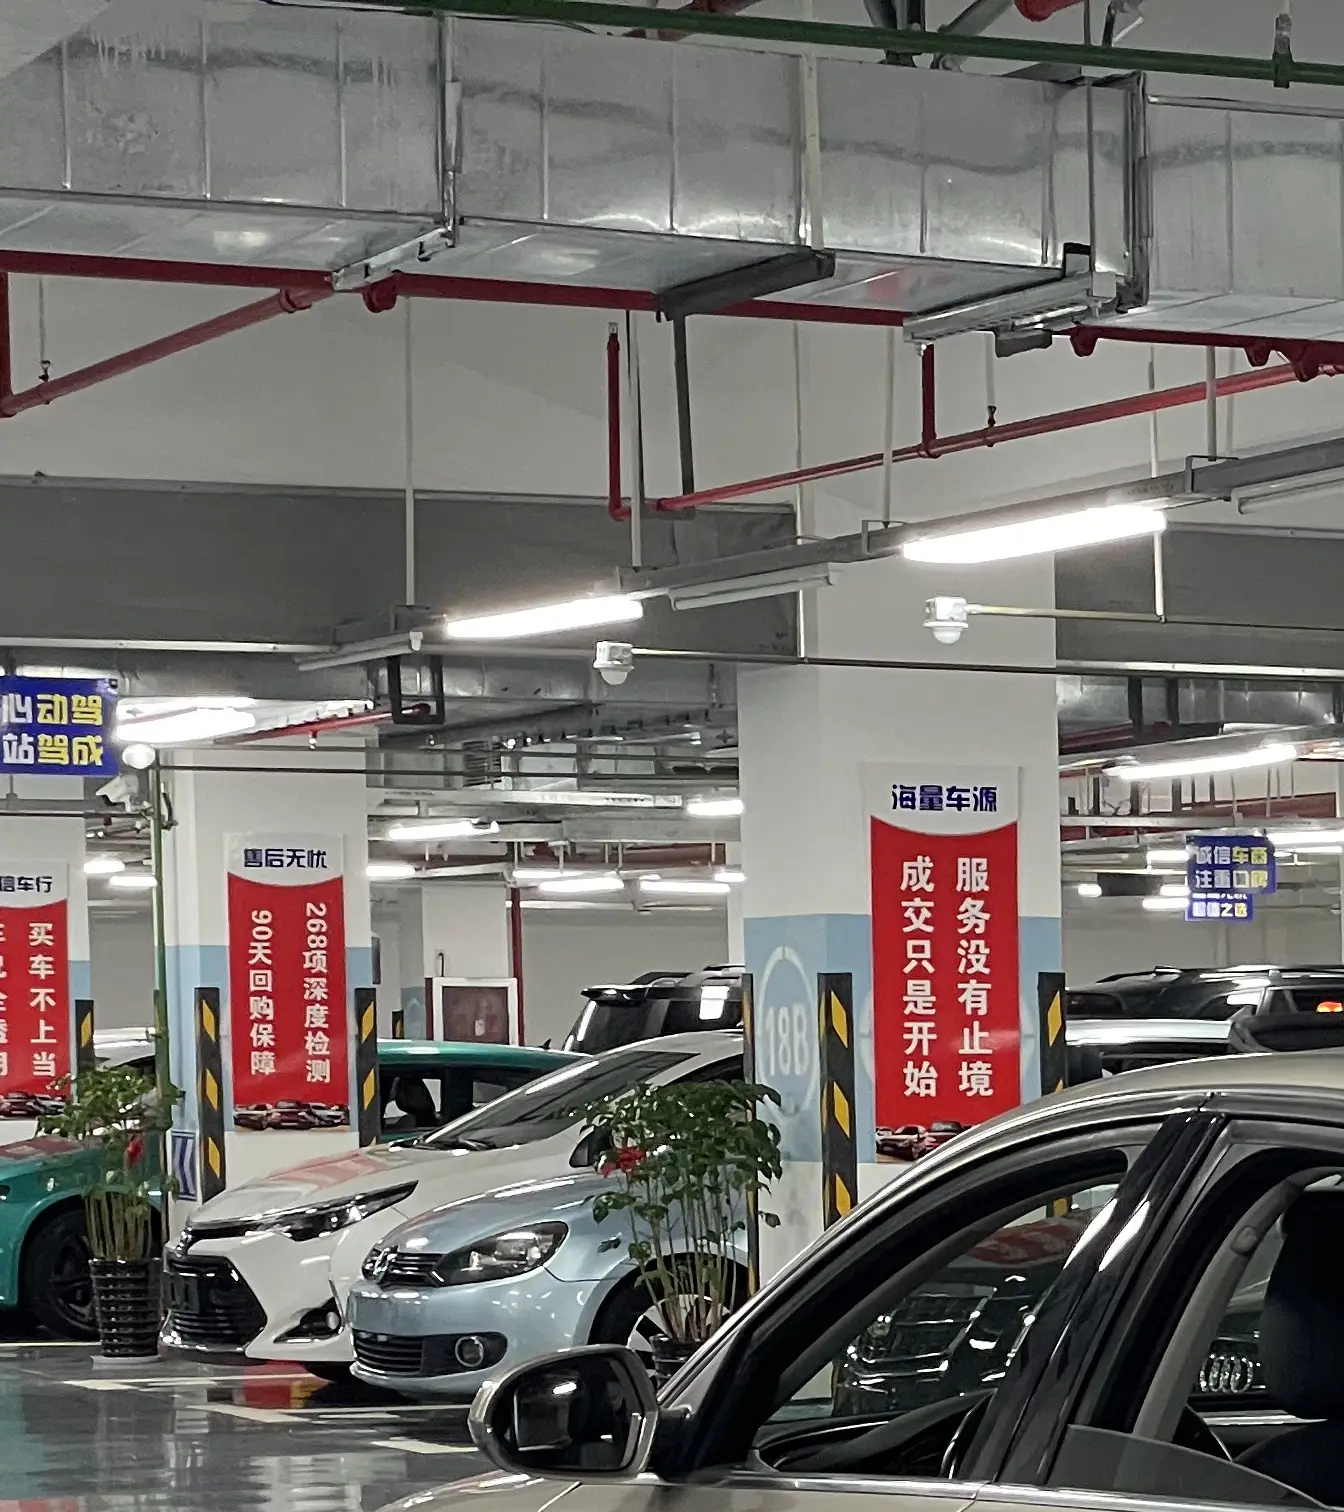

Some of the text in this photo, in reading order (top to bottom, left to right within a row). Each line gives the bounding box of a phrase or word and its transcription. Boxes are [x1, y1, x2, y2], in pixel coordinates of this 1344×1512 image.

[243, 848, 328, 869] 售后无忧
[891, 784, 998, 812] 海量车源
[28, 922, 58, 1078] 买车不上当
[248, 909, 277, 1077] 90天回购保障
[302, 902, 331, 1084] 268项深度检测
[899, 854, 938, 1098] 成交只是开始
[955, 857, 994, 1098] 服务没有止境
